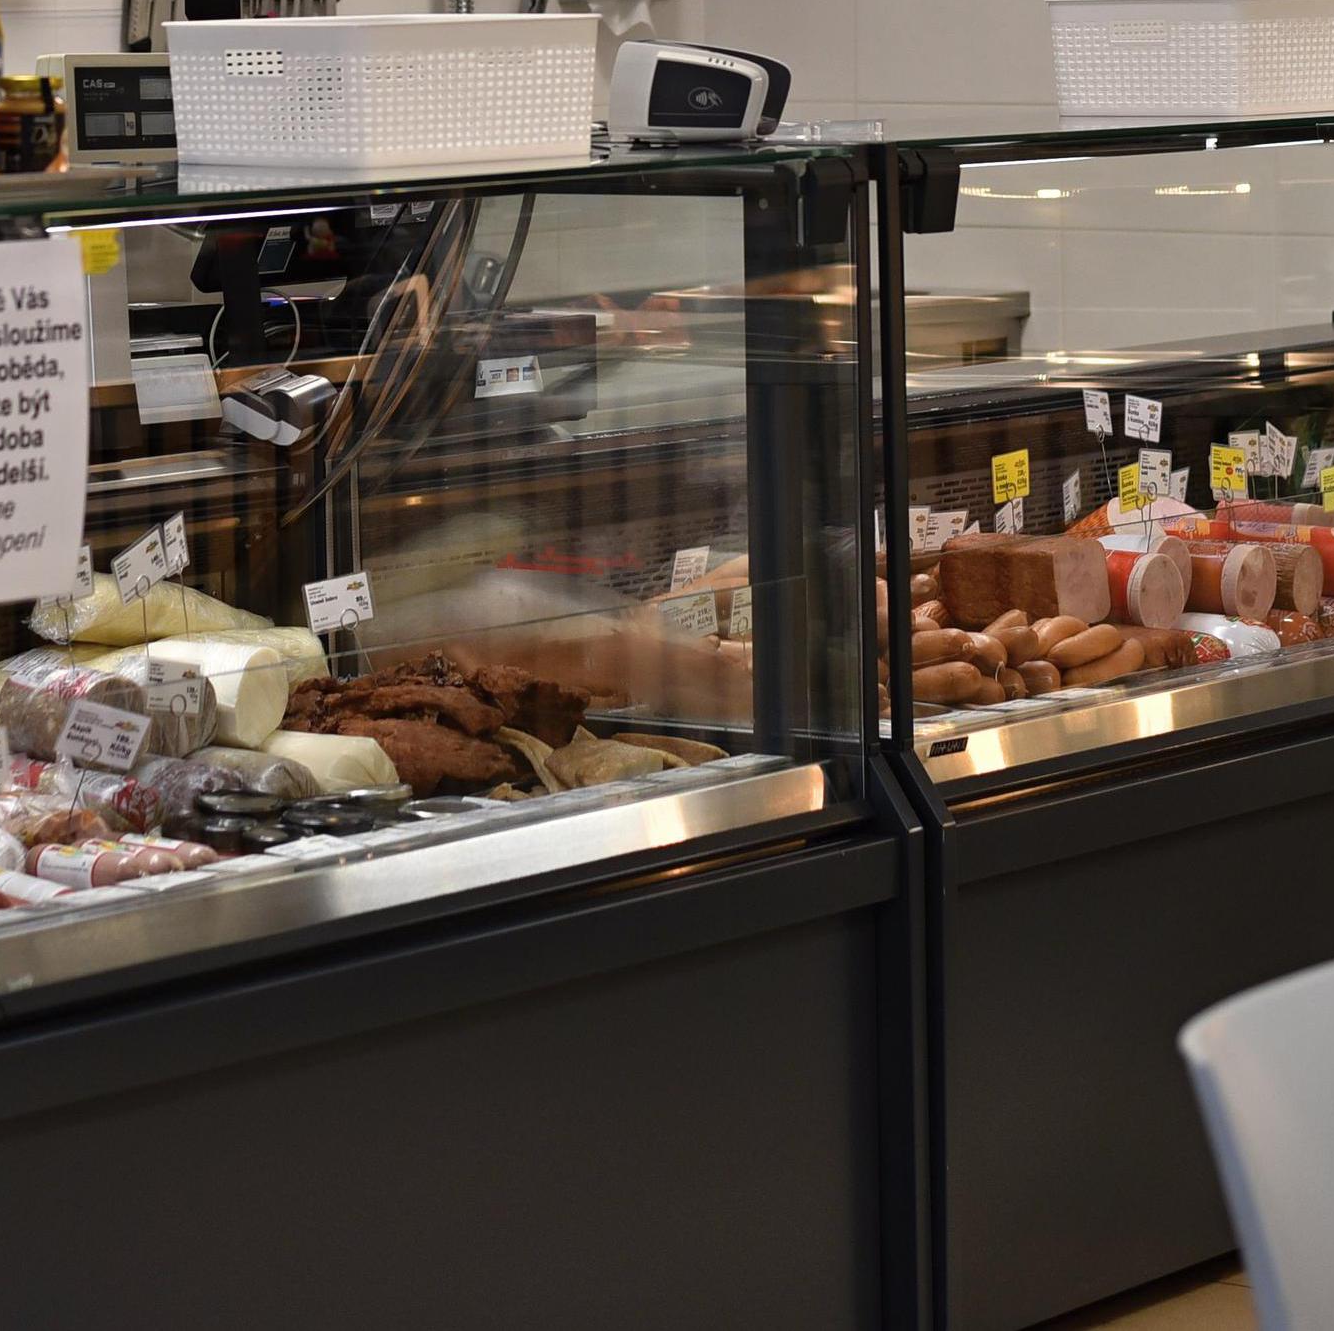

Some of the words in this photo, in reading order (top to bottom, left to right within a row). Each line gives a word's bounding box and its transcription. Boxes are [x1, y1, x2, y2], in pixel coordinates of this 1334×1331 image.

[82, 78, 103, 89] CAS
[11, 286, 50, 311] Vás
[18, 388, 51, 420] být
